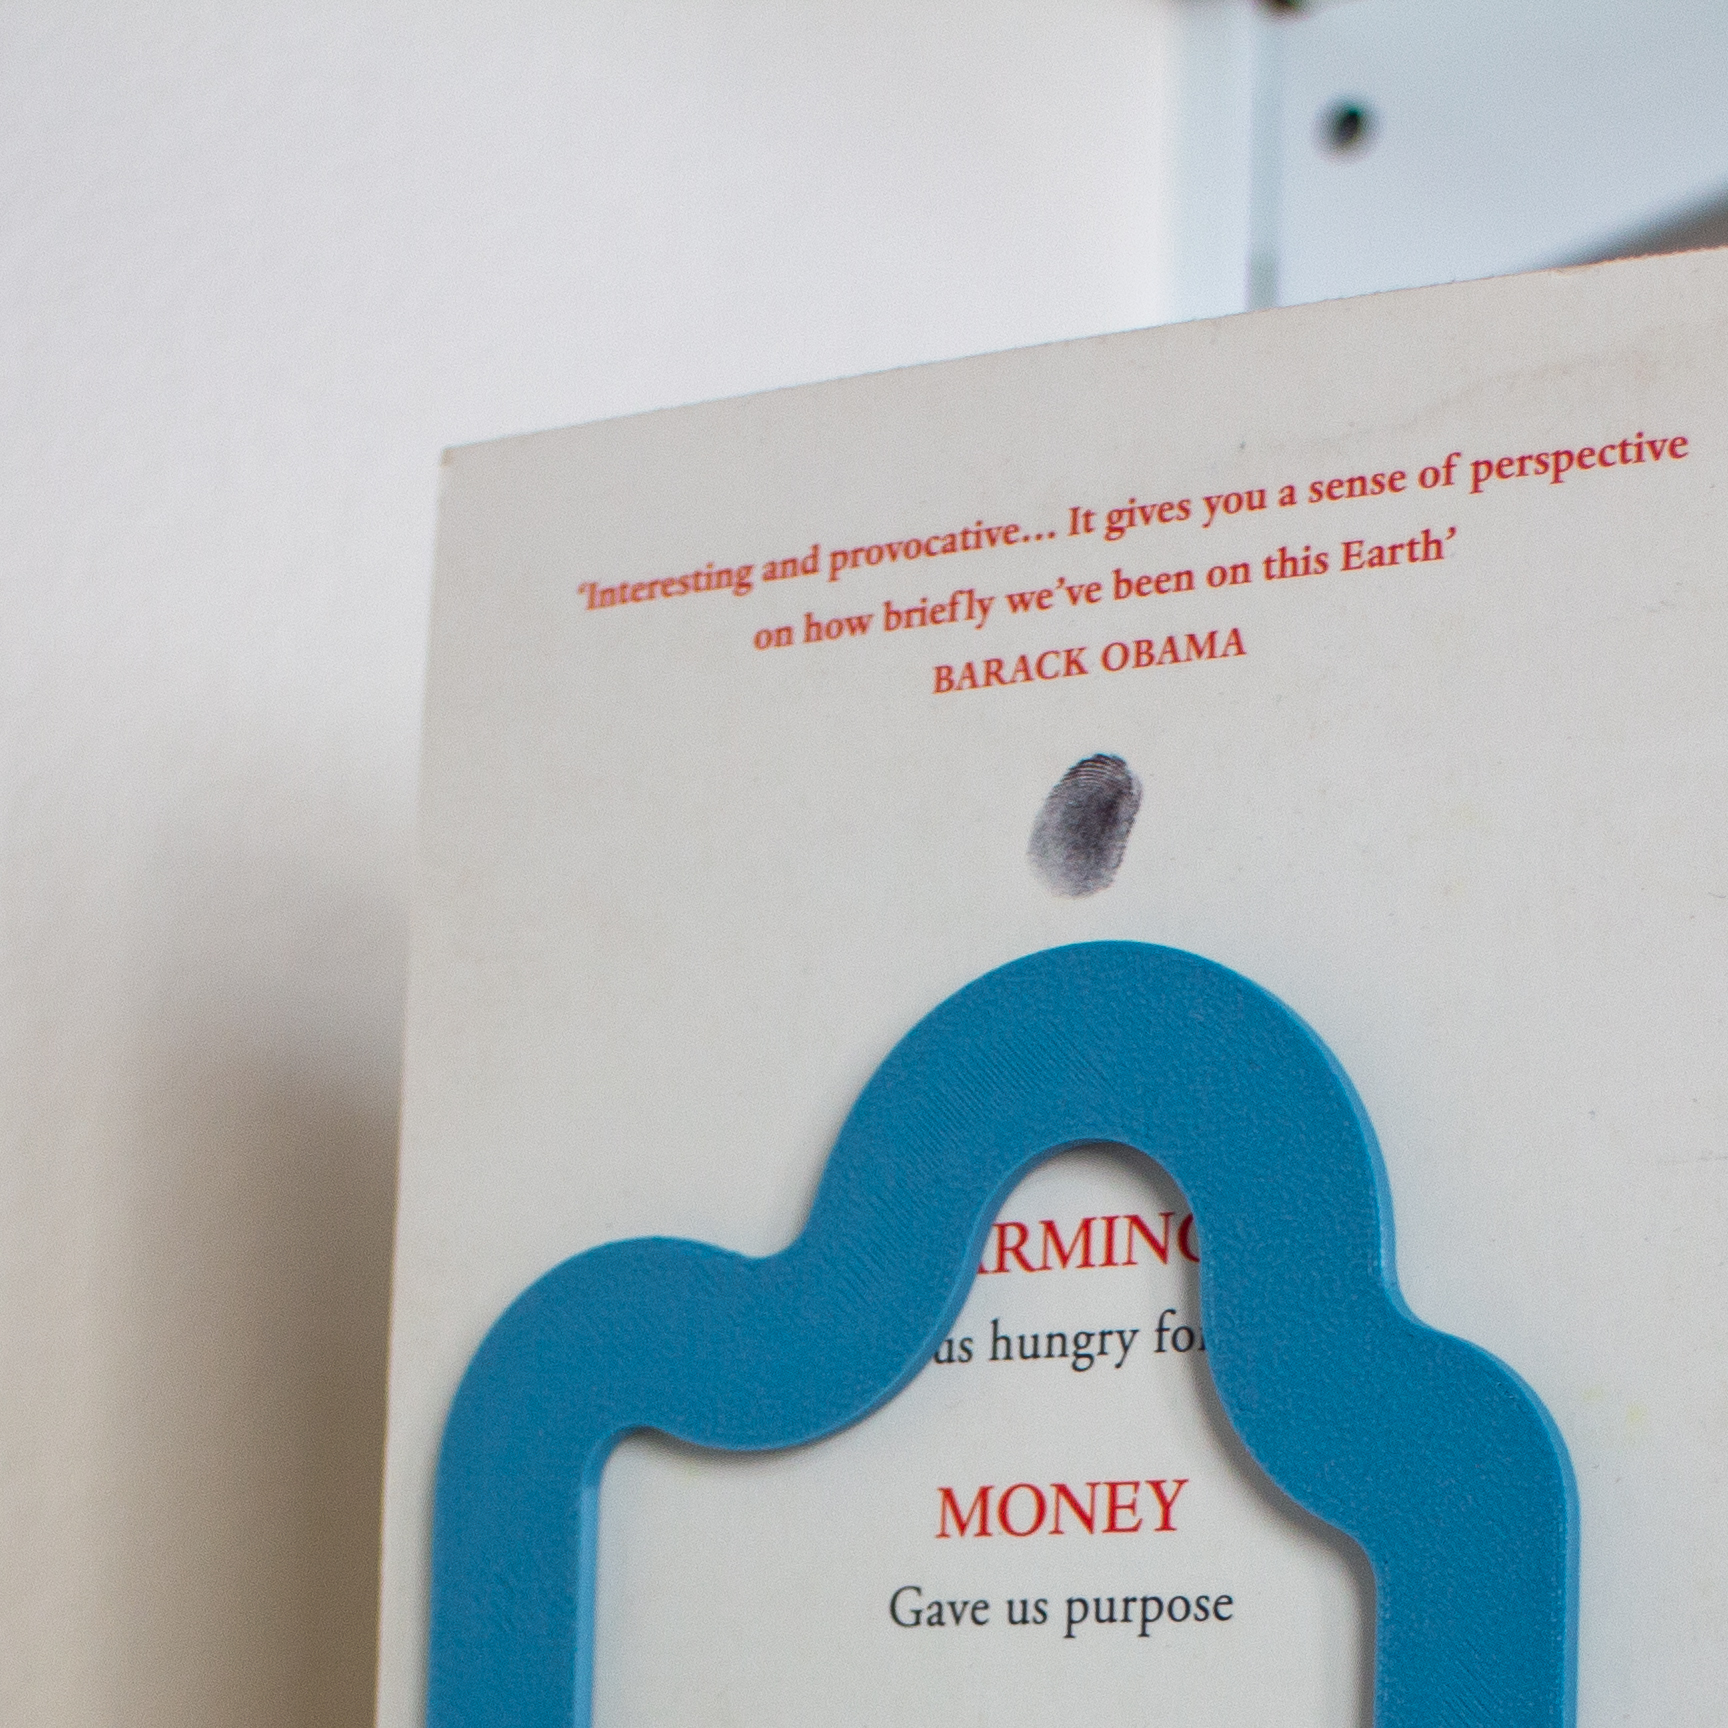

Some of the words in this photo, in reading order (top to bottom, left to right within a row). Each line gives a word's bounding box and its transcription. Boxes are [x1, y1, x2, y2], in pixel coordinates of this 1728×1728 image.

[762, 543, 820, 582] and
[1069, 506, 1096, 536] It
[1104, 497, 1191, 541] gives
[1202, 489, 1267, 528] you
[1278, 484, 1297, 507] a
[1309, 470, 1407, 503] sense
[1418, 452, 1462, 489] of
[1470, 431, 1688, 494] perspective
[753, 625, 794, 650] on
[803, 612, 874, 643] how
[883, 588, 995, 632] briefly
[1113, 568, 1195, 600] been
[1206, 562, 1251, 588] on
[1263, 545, 1329, 580] this
[934, 646, 1088, 693] BARACK
[1101, 627, 1246, 672] OBAMA
[989, 1318, 1139, 1373] hungry
[937, 1479, 1188, 1538] MONEY
[889, 1586, 990, 1628] Gave
[1007, 1598, 1048, 1625] us
[1064, 1595, 1233, 1639] purpose
